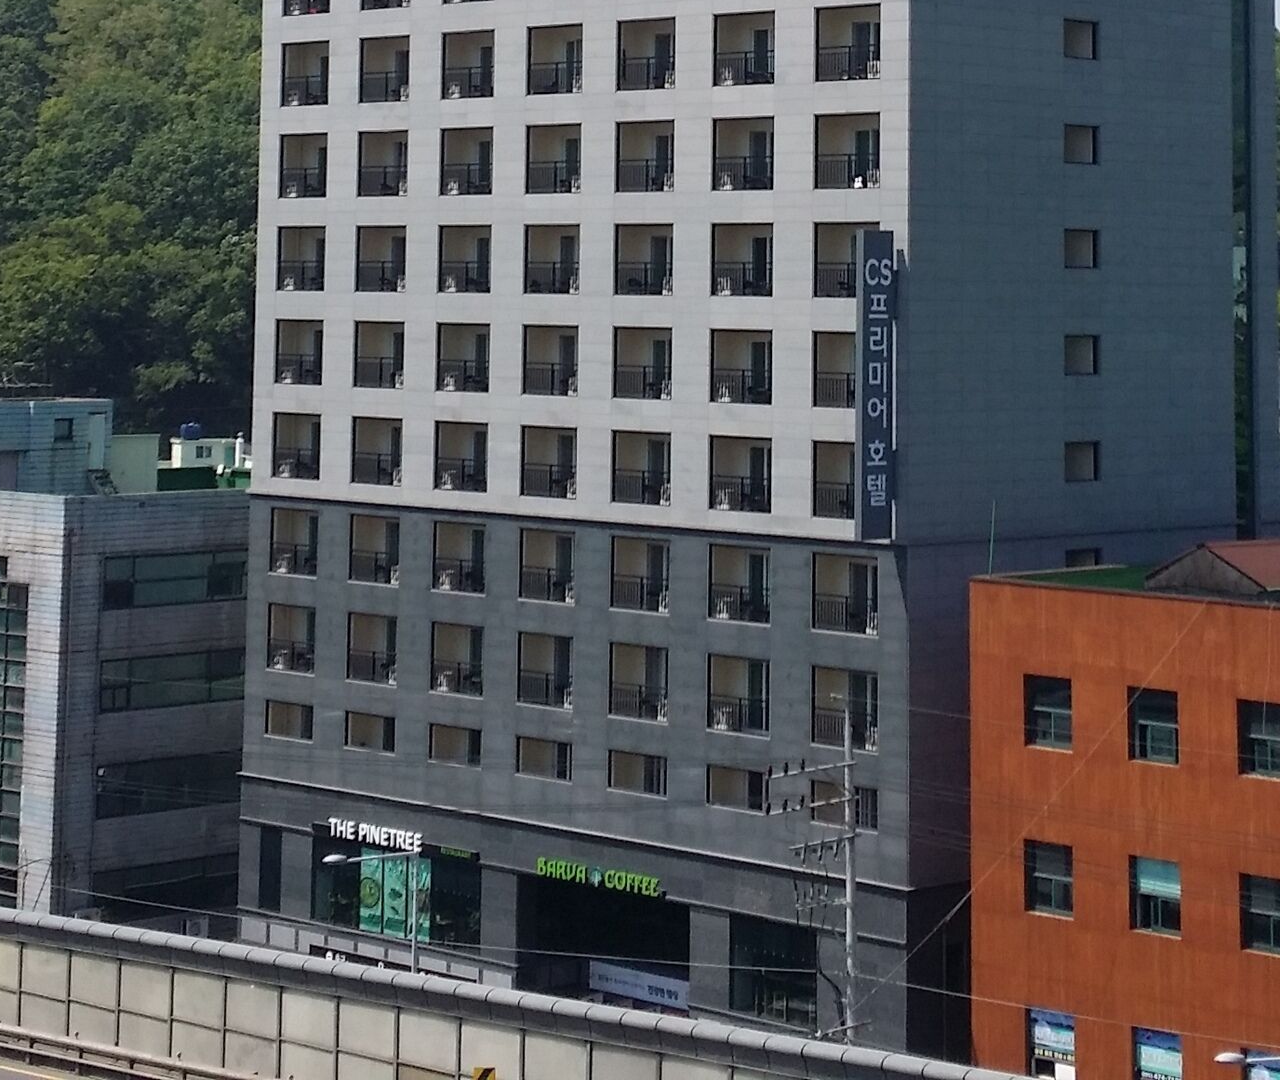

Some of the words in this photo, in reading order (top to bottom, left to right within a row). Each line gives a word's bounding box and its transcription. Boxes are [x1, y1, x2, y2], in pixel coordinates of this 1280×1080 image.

[864, 258, 892, 286] CS
[867, 293, 889, 429] 프리미어
[867, 439, 888, 507] 호텔
[328, 817, 356, 841] THE
[358, 823, 423, 854] PINETREE
[604, 869, 660, 898] COFFEE
